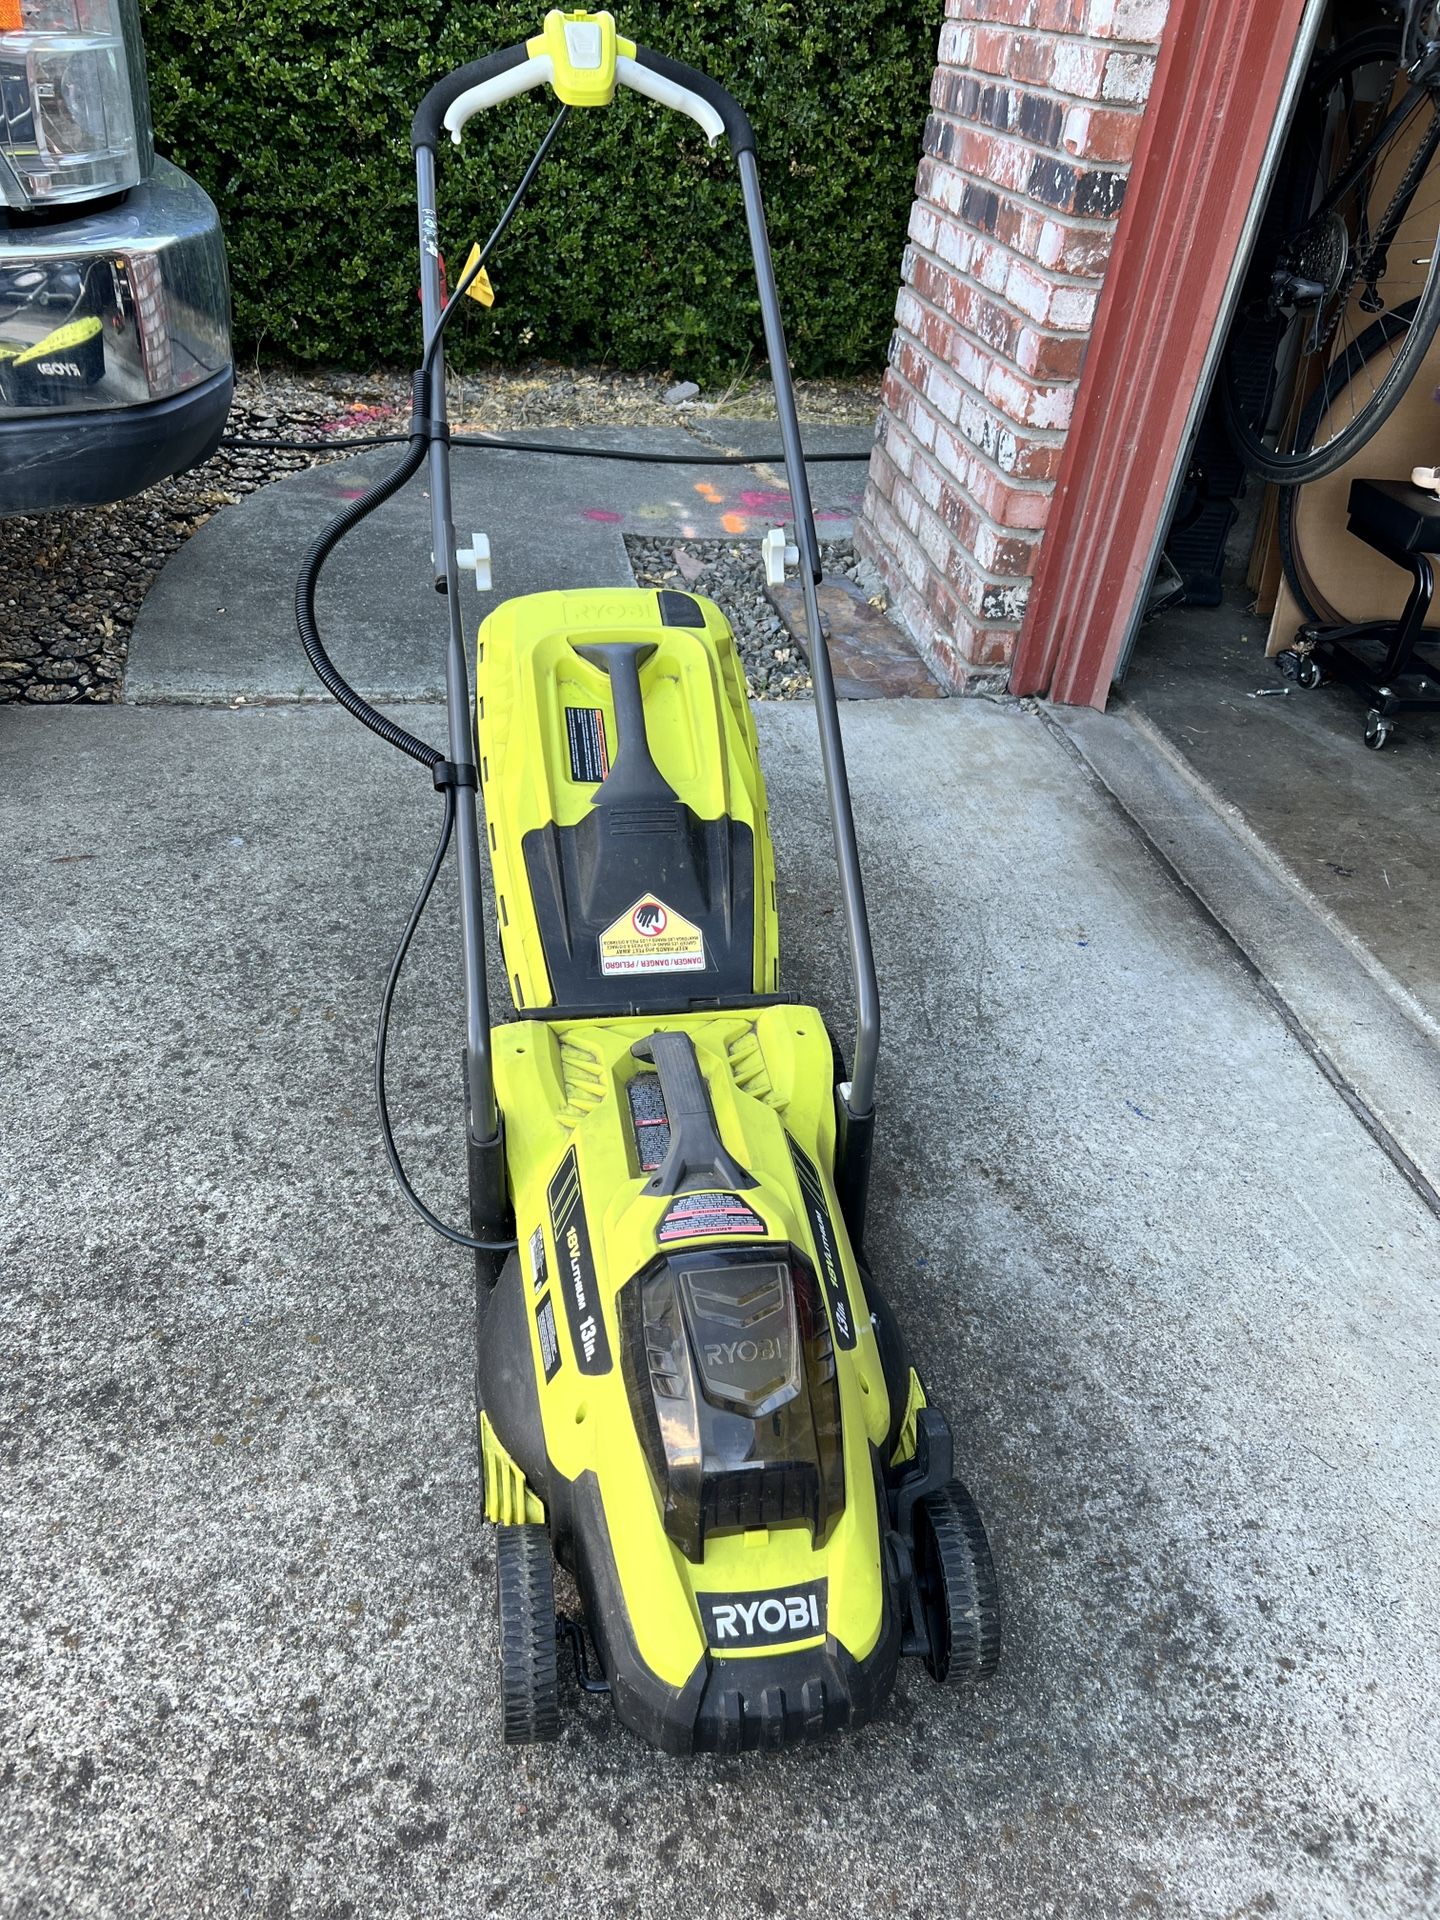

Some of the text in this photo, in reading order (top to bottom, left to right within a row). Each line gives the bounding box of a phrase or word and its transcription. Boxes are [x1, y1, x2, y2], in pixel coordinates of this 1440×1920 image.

[605, 960, 635, 969] PELIGRO
[641, 959, 670, 968] DANGER
[674, 957, 702, 966] DANGER
[703, 1337, 782, 1366] RYOBI
[711, 1594, 820, 1639] RYOBI
